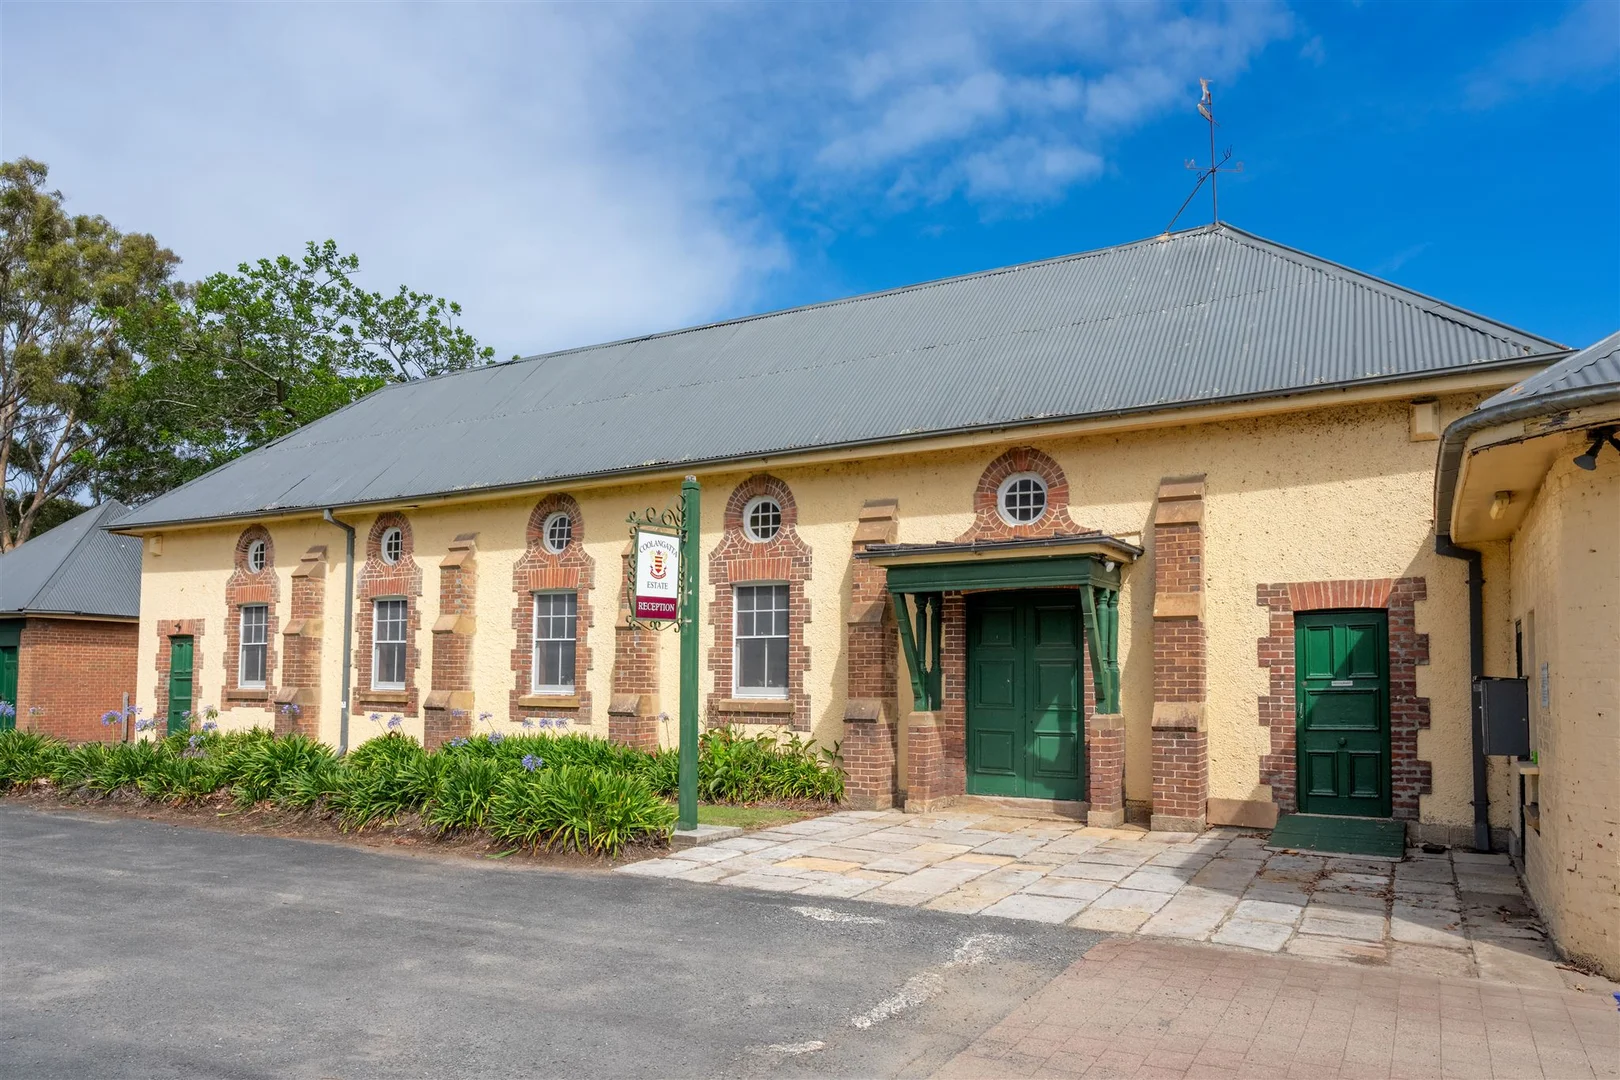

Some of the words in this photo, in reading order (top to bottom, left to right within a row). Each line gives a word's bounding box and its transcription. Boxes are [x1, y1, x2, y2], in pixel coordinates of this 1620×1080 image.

[639, 540, 678, 558] COOLANGATTA
[646, 580, 668, 590] ESTATE
[638, 602, 675, 612] RECEPTION
